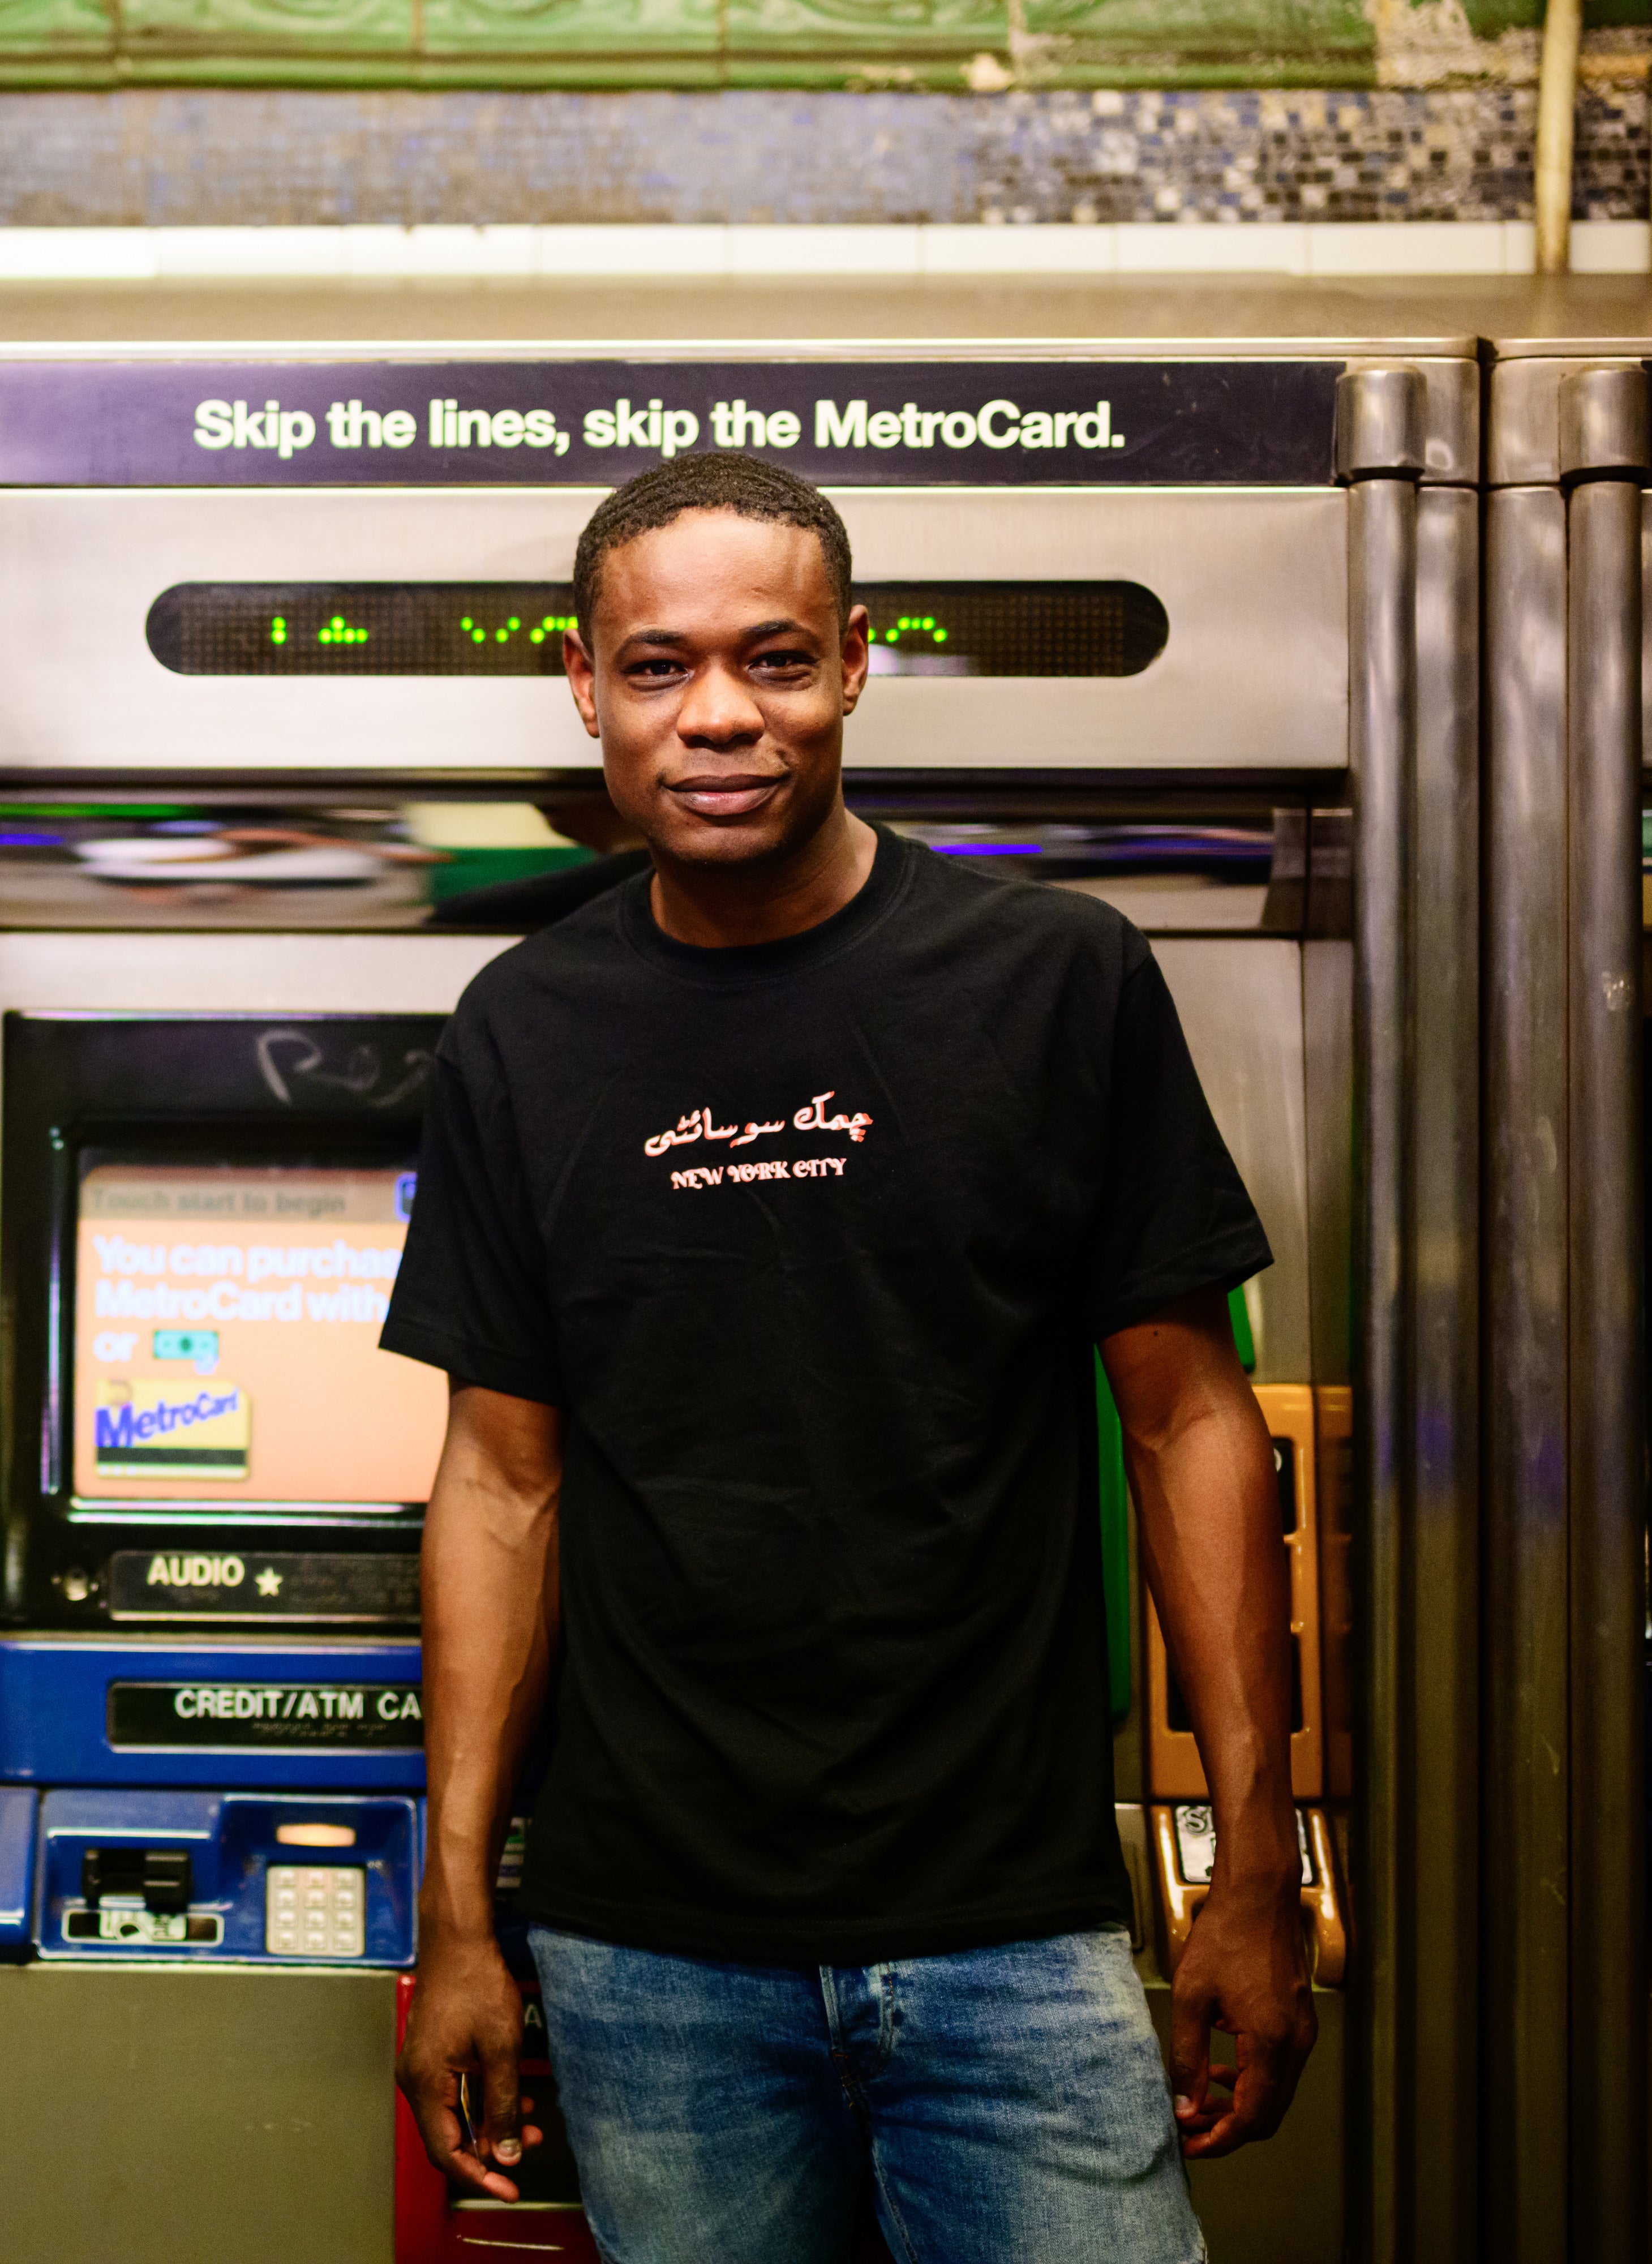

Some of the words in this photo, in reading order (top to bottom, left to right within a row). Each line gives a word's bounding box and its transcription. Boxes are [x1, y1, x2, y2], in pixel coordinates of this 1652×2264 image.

[194, 398, 316, 460] Skip
[325, 398, 417, 449] the
[429, 398, 570, 456] lines,
[583, 398, 700, 457] skip
[710, 398, 801, 449] the
[815, 399, 1126, 449] MetroCard.
[671, 1166, 725, 1190] NEW
[727, 1160, 791, 1183] YORK
[792, 1157, 847, 1177] CITY
[93, 1236, 166, 1276] You
[168, 1245, 244, 1277] can
[94, 1279, 302, 1322] MetroCard
[306, 1283, 392, 1322] with
[93, 1331, 139, 1362] or
[95, 1384, 239, 1448] MetroCard
[147, 1555, 245, 1587] AUDIO
[174, 1688, 364, 1720] CREDIT/ATM
